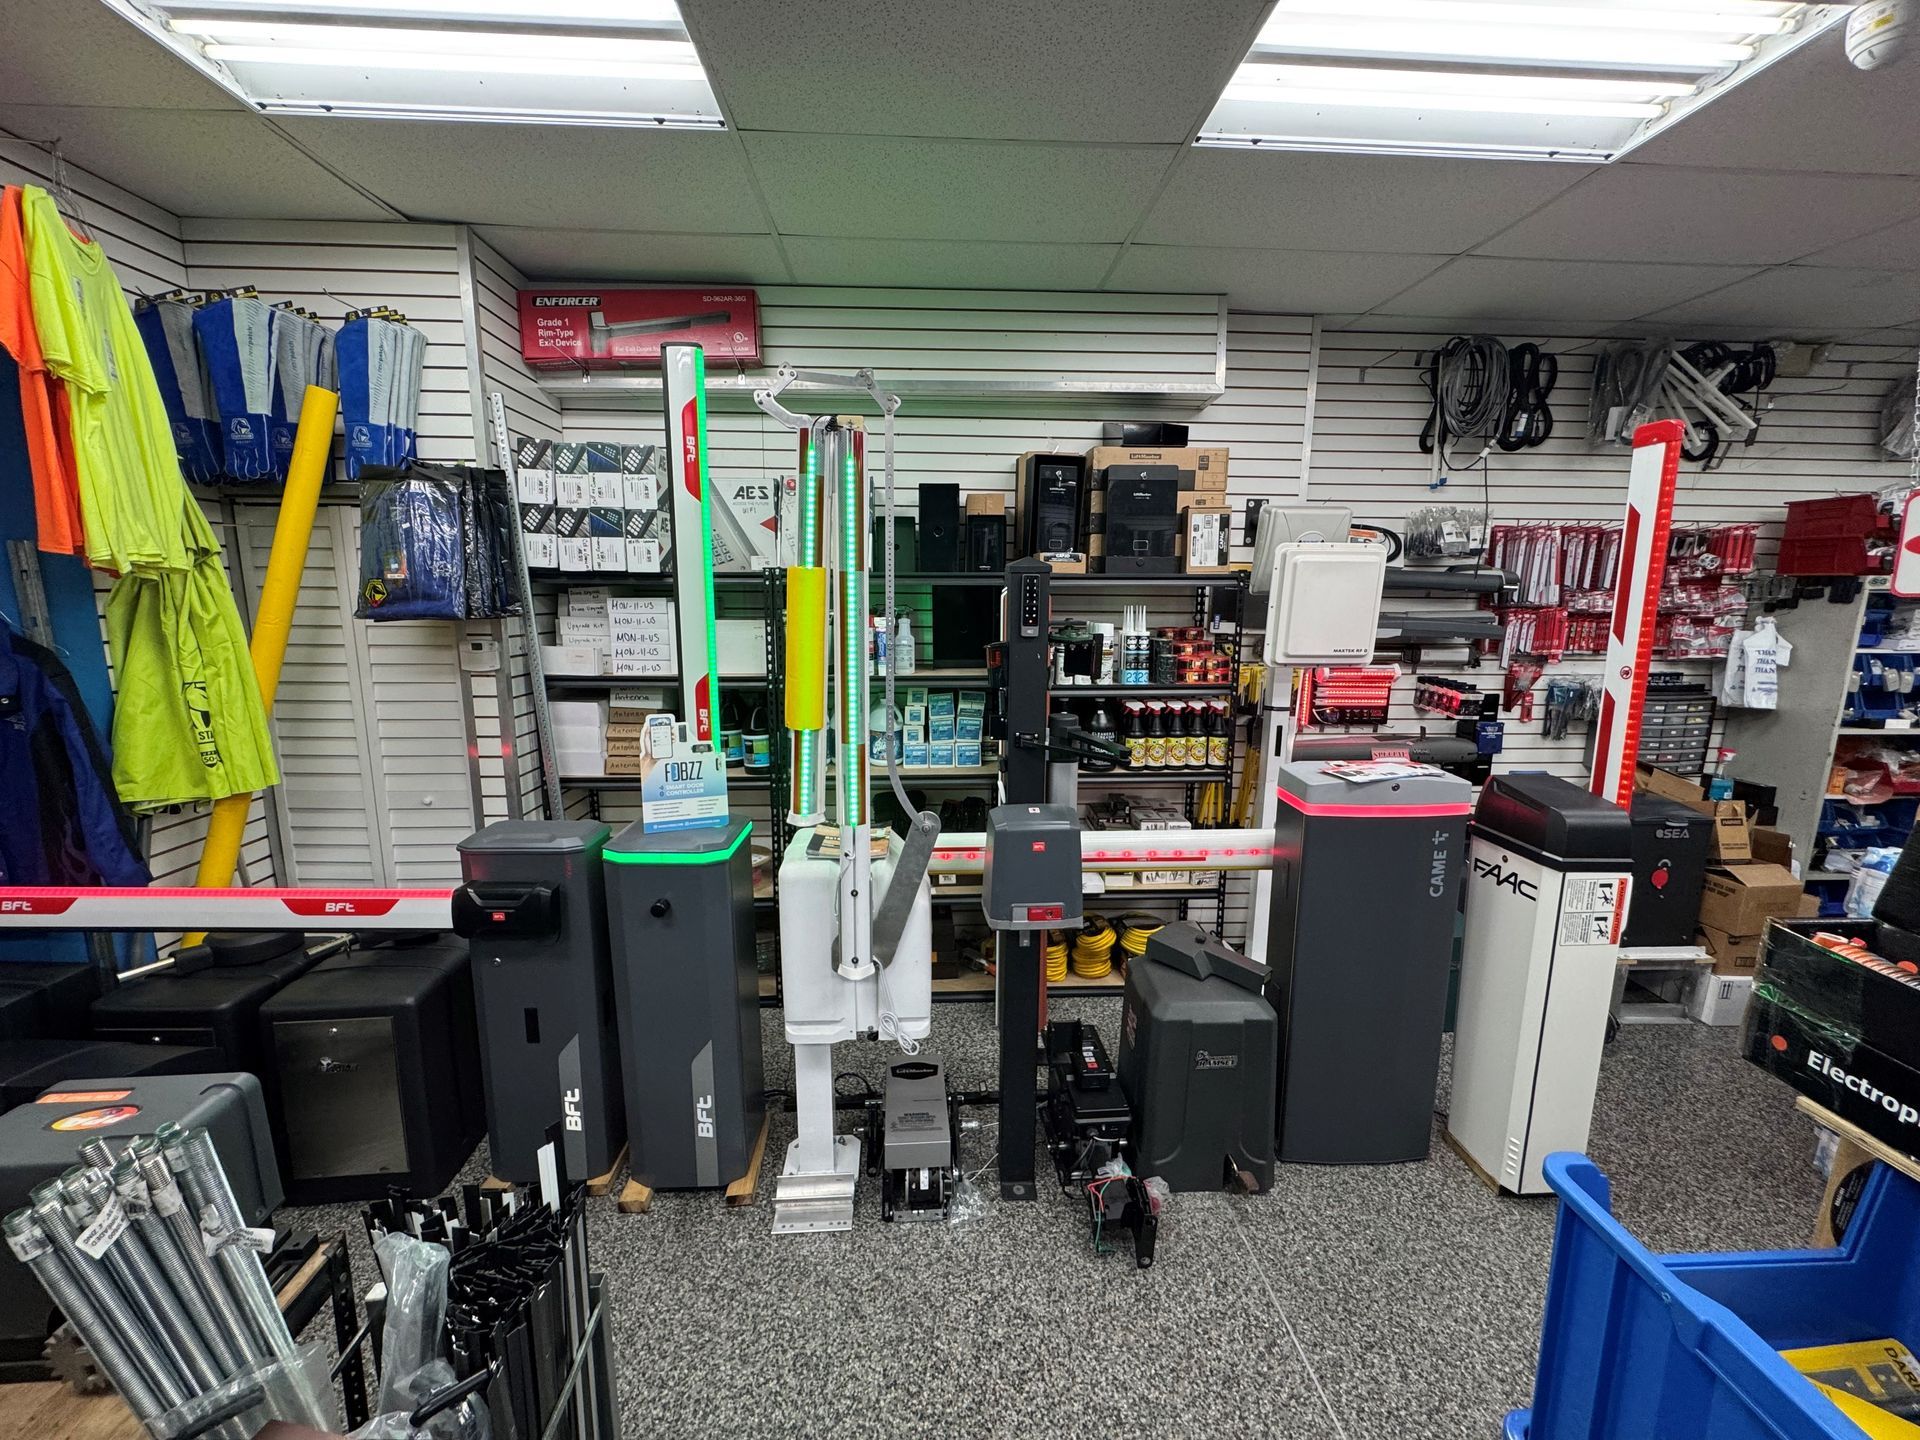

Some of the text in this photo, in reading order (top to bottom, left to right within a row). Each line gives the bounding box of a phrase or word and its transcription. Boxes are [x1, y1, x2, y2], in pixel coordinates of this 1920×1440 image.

[535, 297, 599, 306] ENFORCER
[537, 318, 569, 327] Grade 1
[538, 329, 574, 338] Rim-Type
[539, 339, 582, 347] Exit Device
[732, 486, 769, 500] AES
[614, 690, 650, 701] Antenna
[665, 761, 703, 782] FOBZZ
[1429, 850, 1448, 898] CAME
[1473, 857, 1538, 902] FAAC
[1807, 1050, 1920, 1127] Electrop
